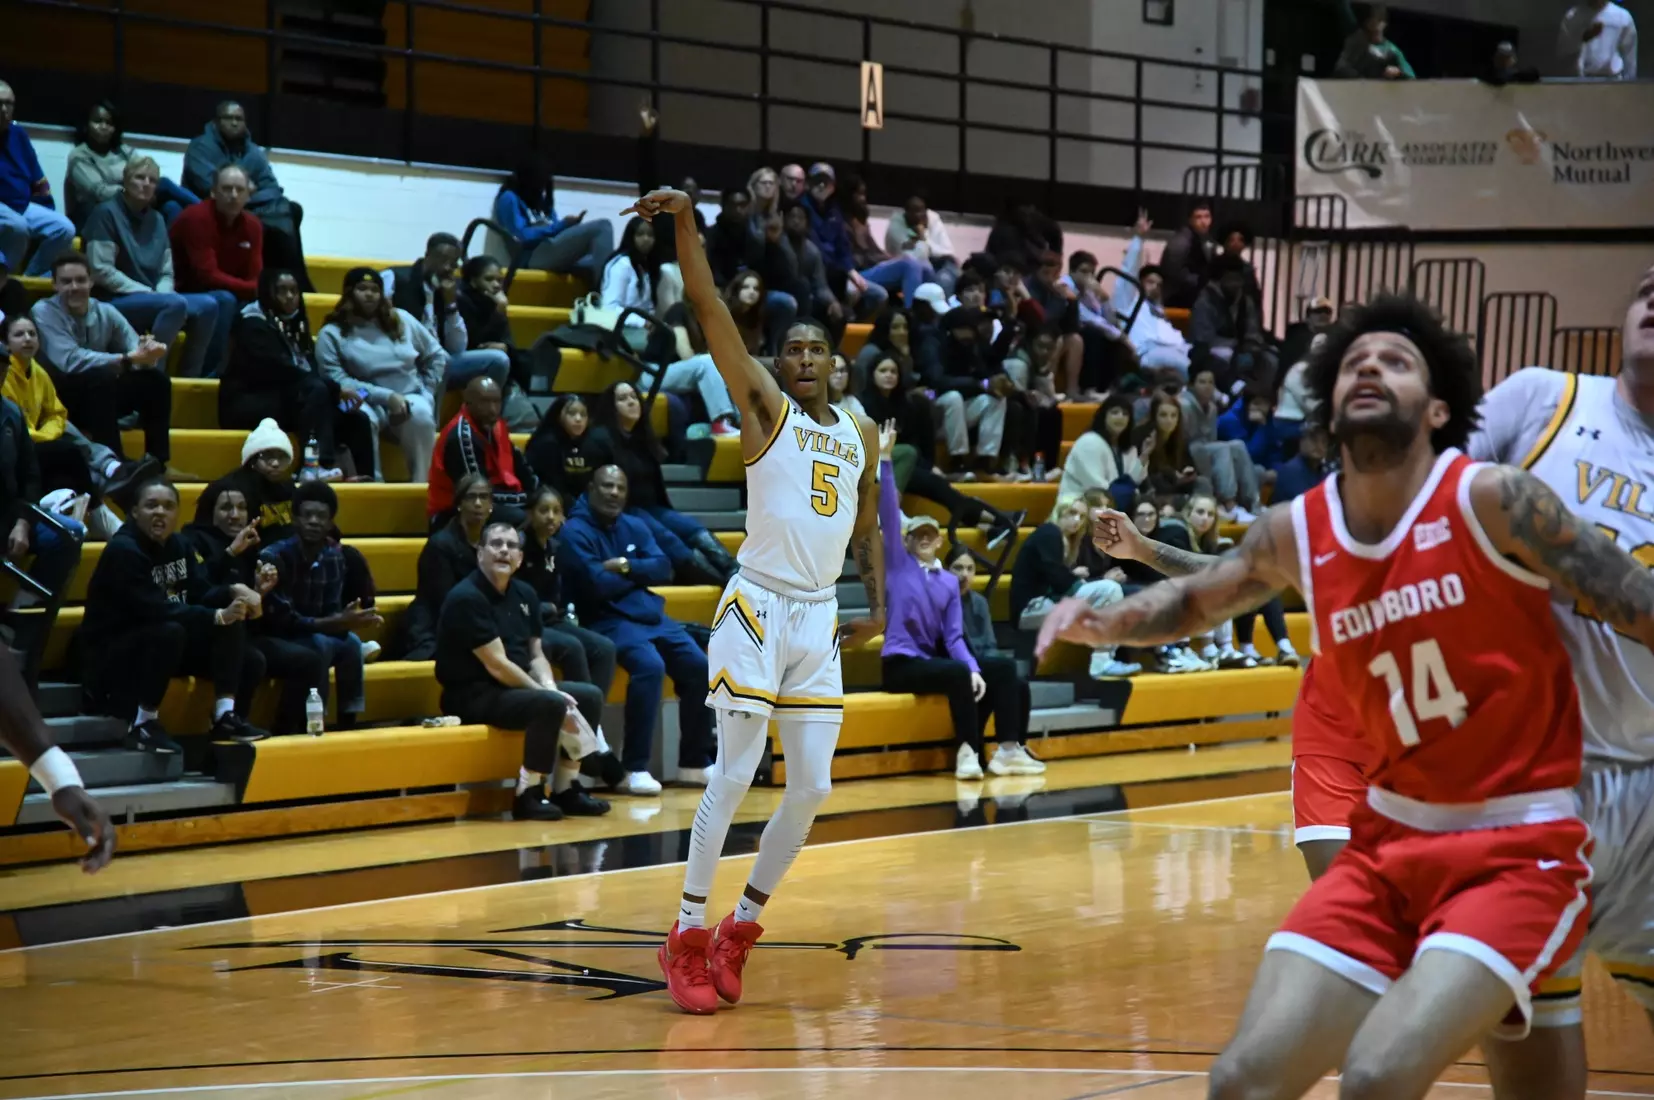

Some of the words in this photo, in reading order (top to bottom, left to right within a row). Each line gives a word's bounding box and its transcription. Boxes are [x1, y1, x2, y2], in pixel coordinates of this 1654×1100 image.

[864, 65, 881, 126] A
[1304, 128, 1389, 178] CLARK
[1553, 161, 1631, 184] Mutual
[793, 426, 859, 468] VILLE
[811, 460, 840, 517] 5
[1367, 638, 1469, 748] 14
